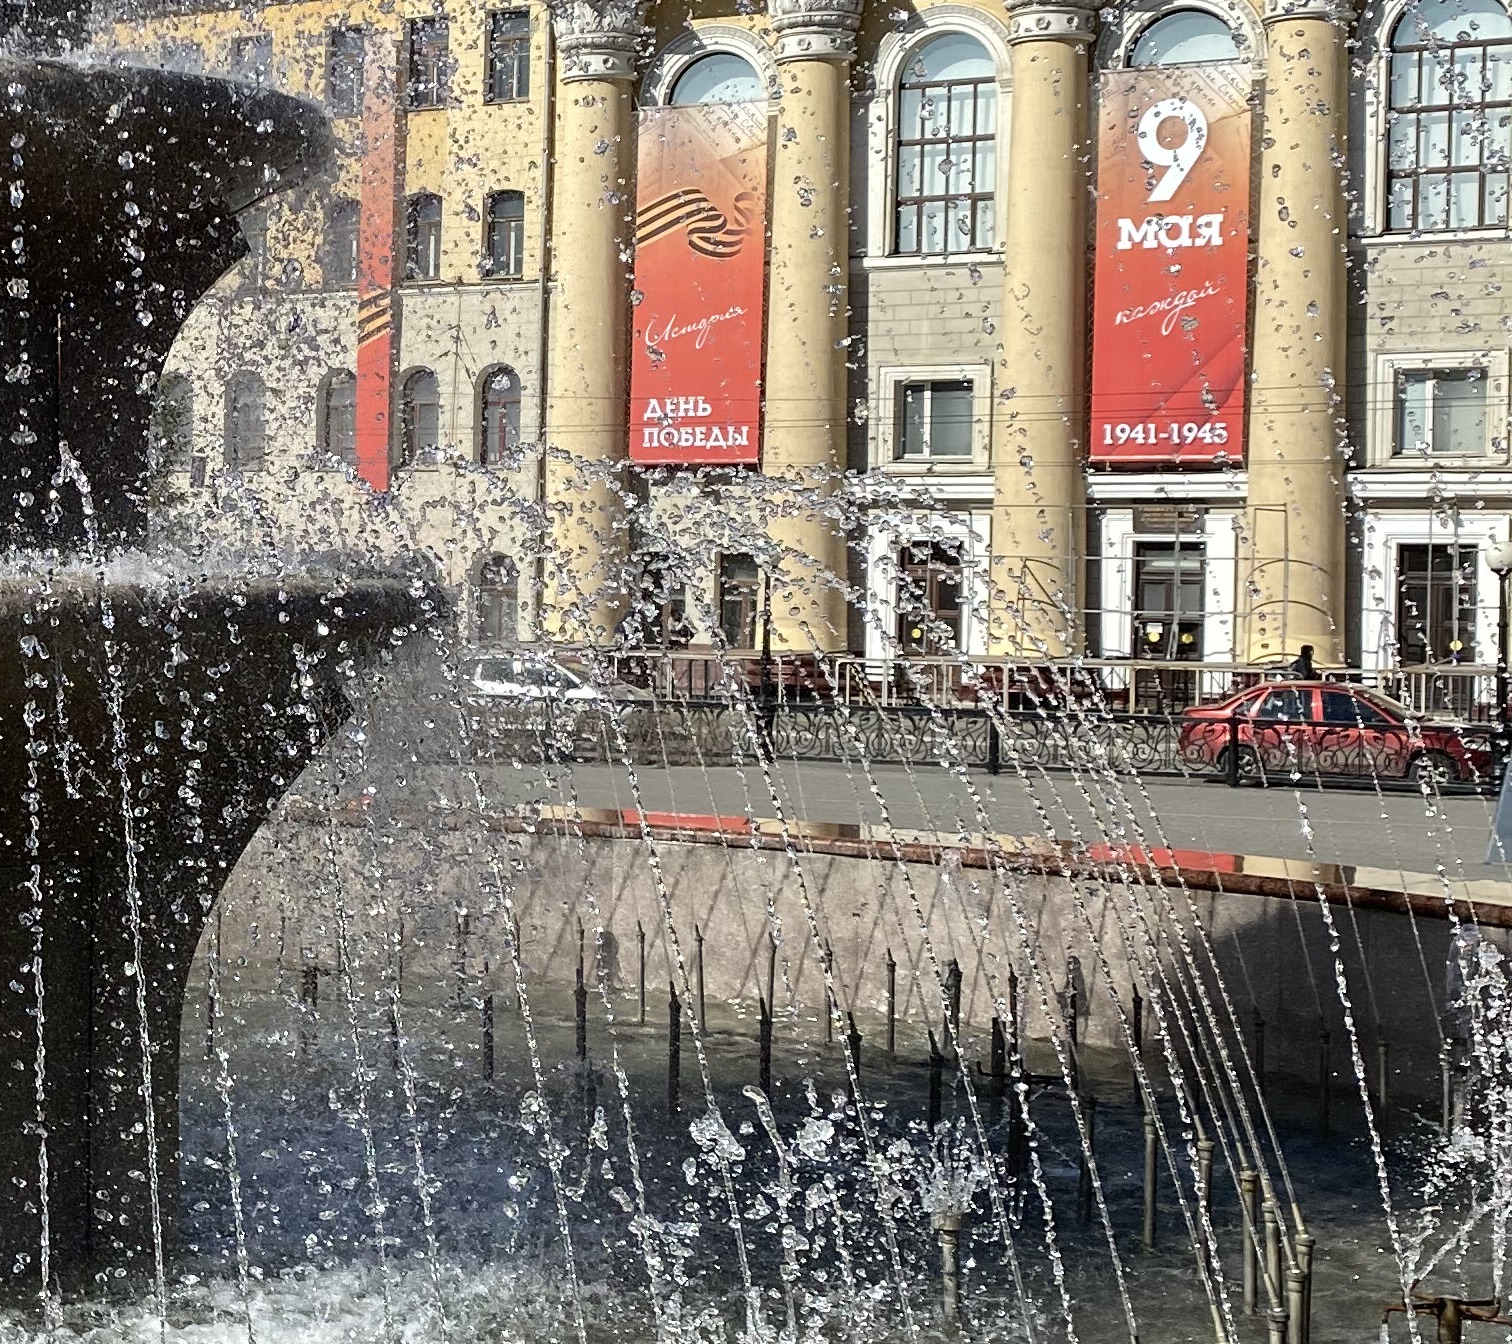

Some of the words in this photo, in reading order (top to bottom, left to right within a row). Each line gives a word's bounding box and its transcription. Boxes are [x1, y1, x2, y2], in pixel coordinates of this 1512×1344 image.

[1137, 97, 1208, 202] 9
[1114, 281, 1221, 336] каждой
[644, 304, 748, 350] История
[643, 395, 712, 421] ДЕНЬ
[642, 425, 749, 448] ПОБЕДЫ
[1103, 423, 1228, 446] 1941-1945
